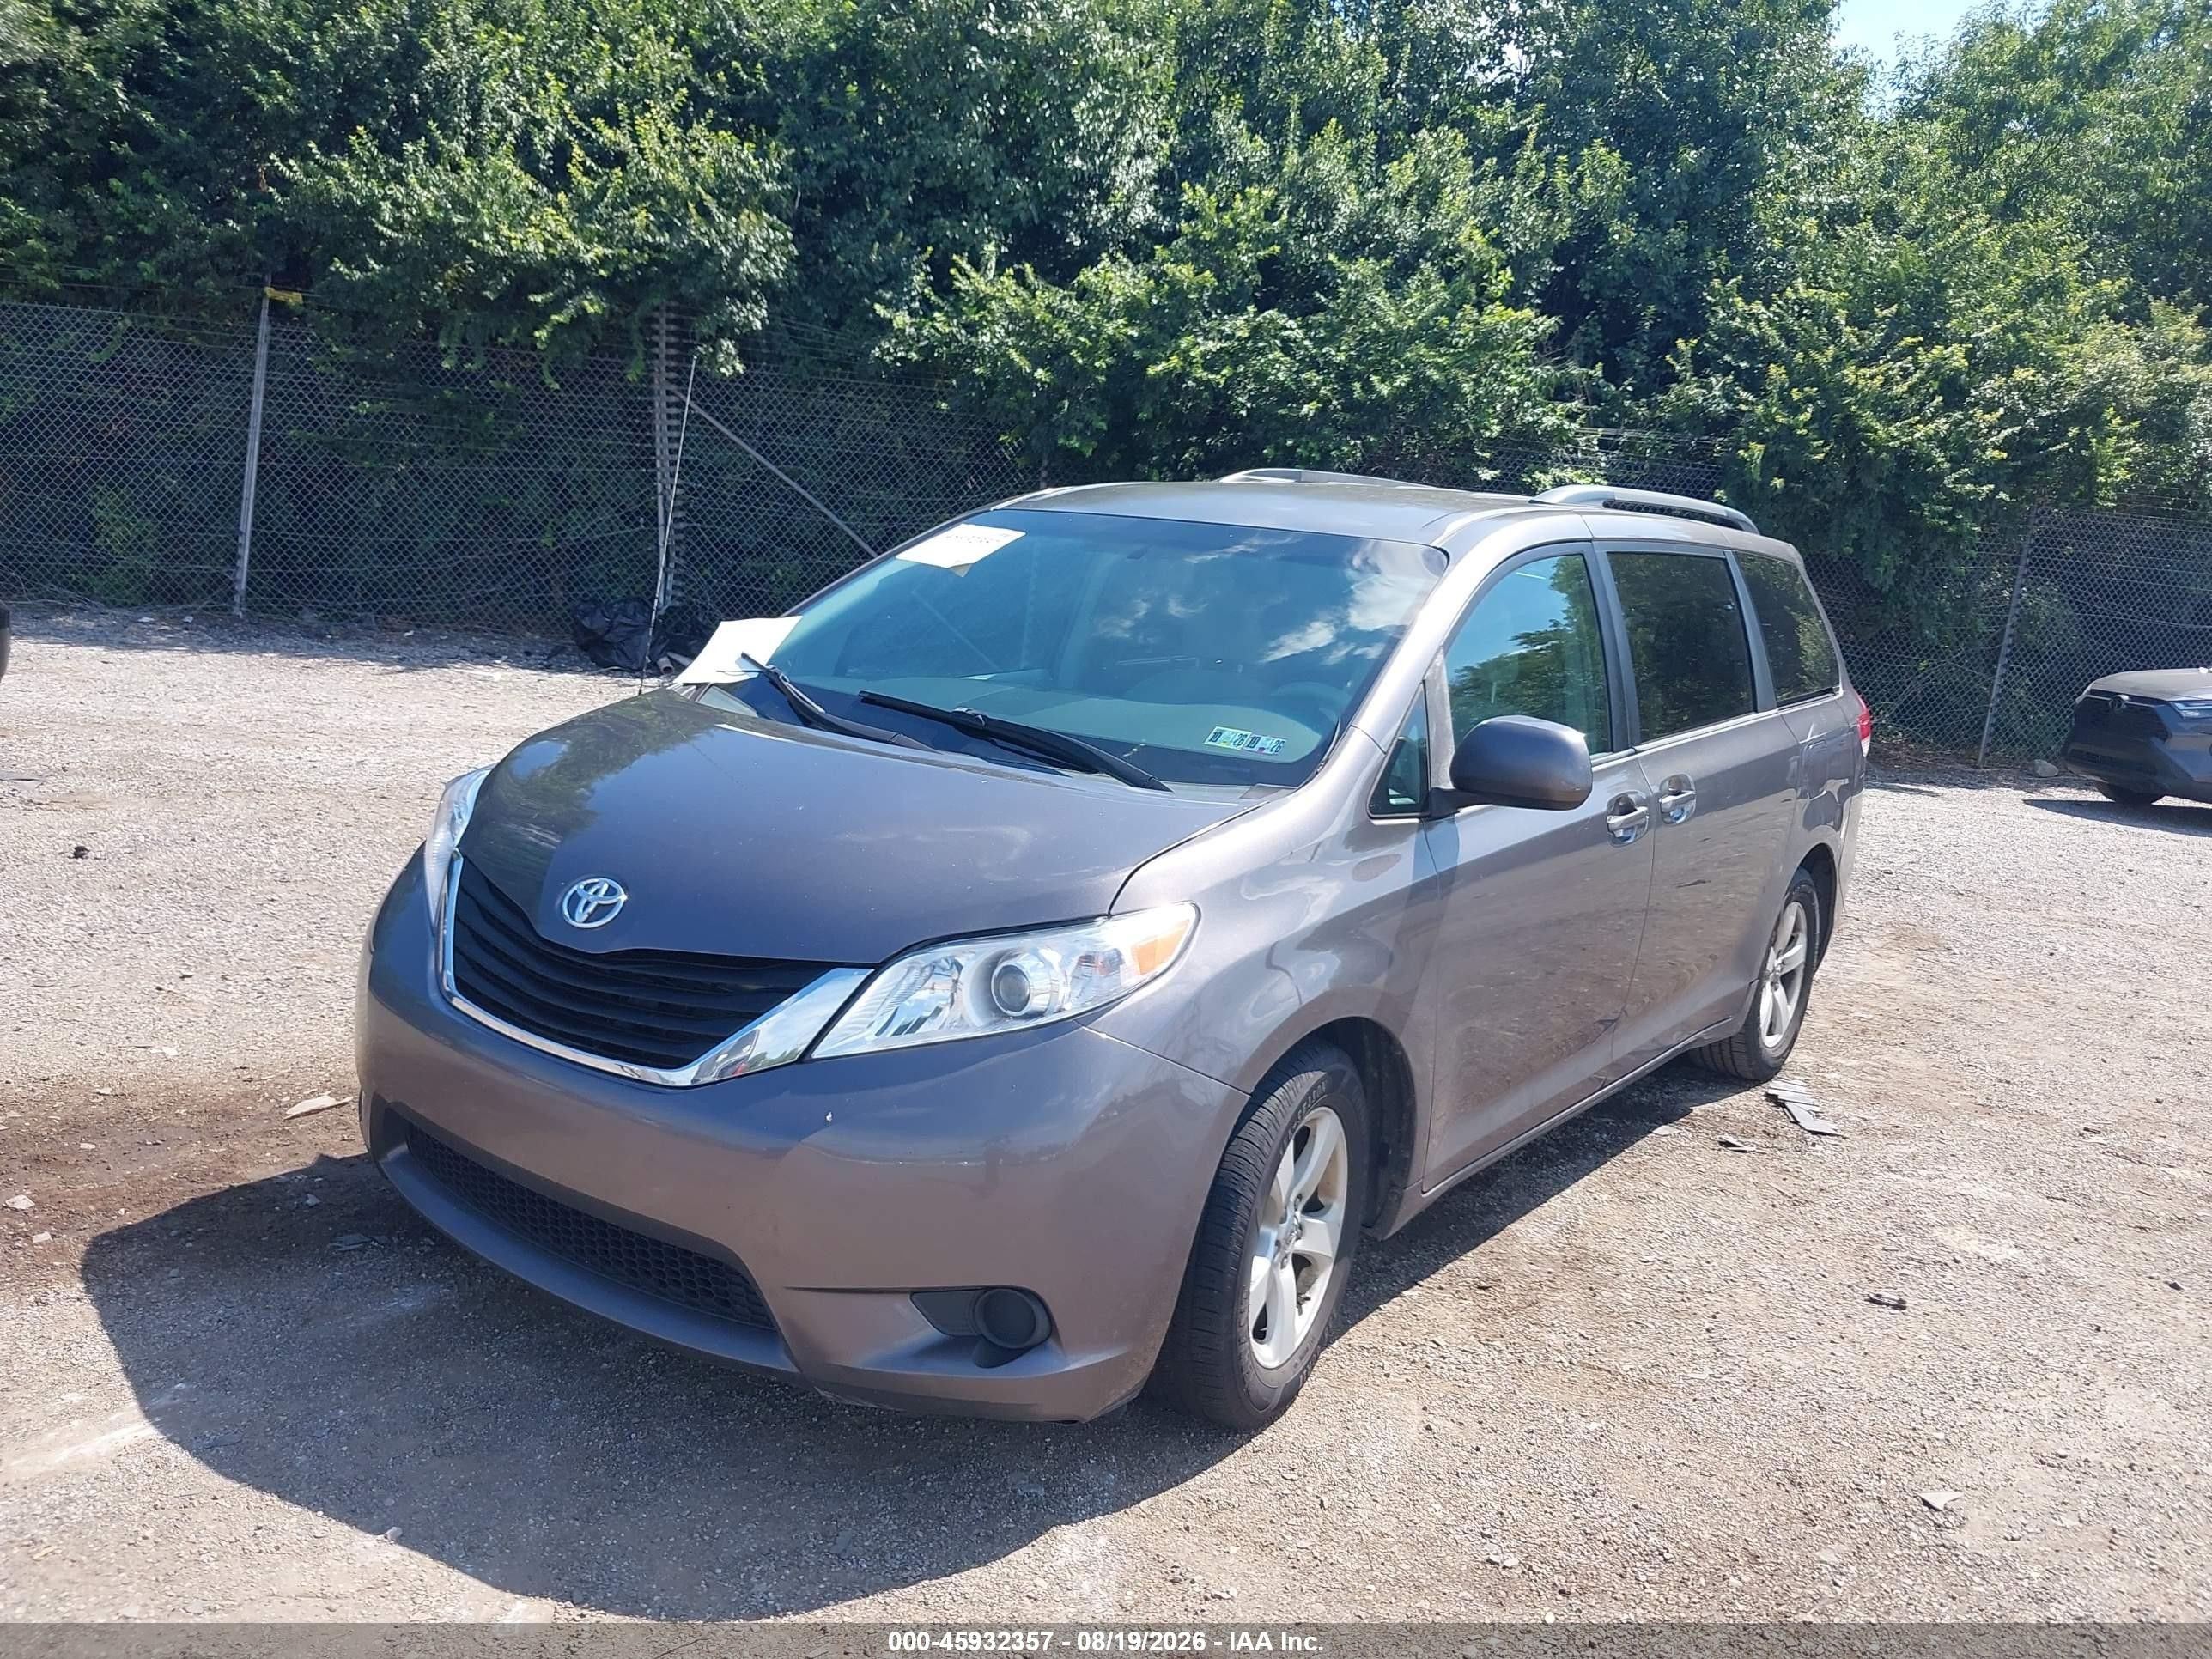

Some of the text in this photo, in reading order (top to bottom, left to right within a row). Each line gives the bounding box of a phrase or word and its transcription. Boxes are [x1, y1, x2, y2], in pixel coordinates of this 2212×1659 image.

[1209, 732, 1248, 746] 10 26
[1247, 736, 1285, 753] 10 26
